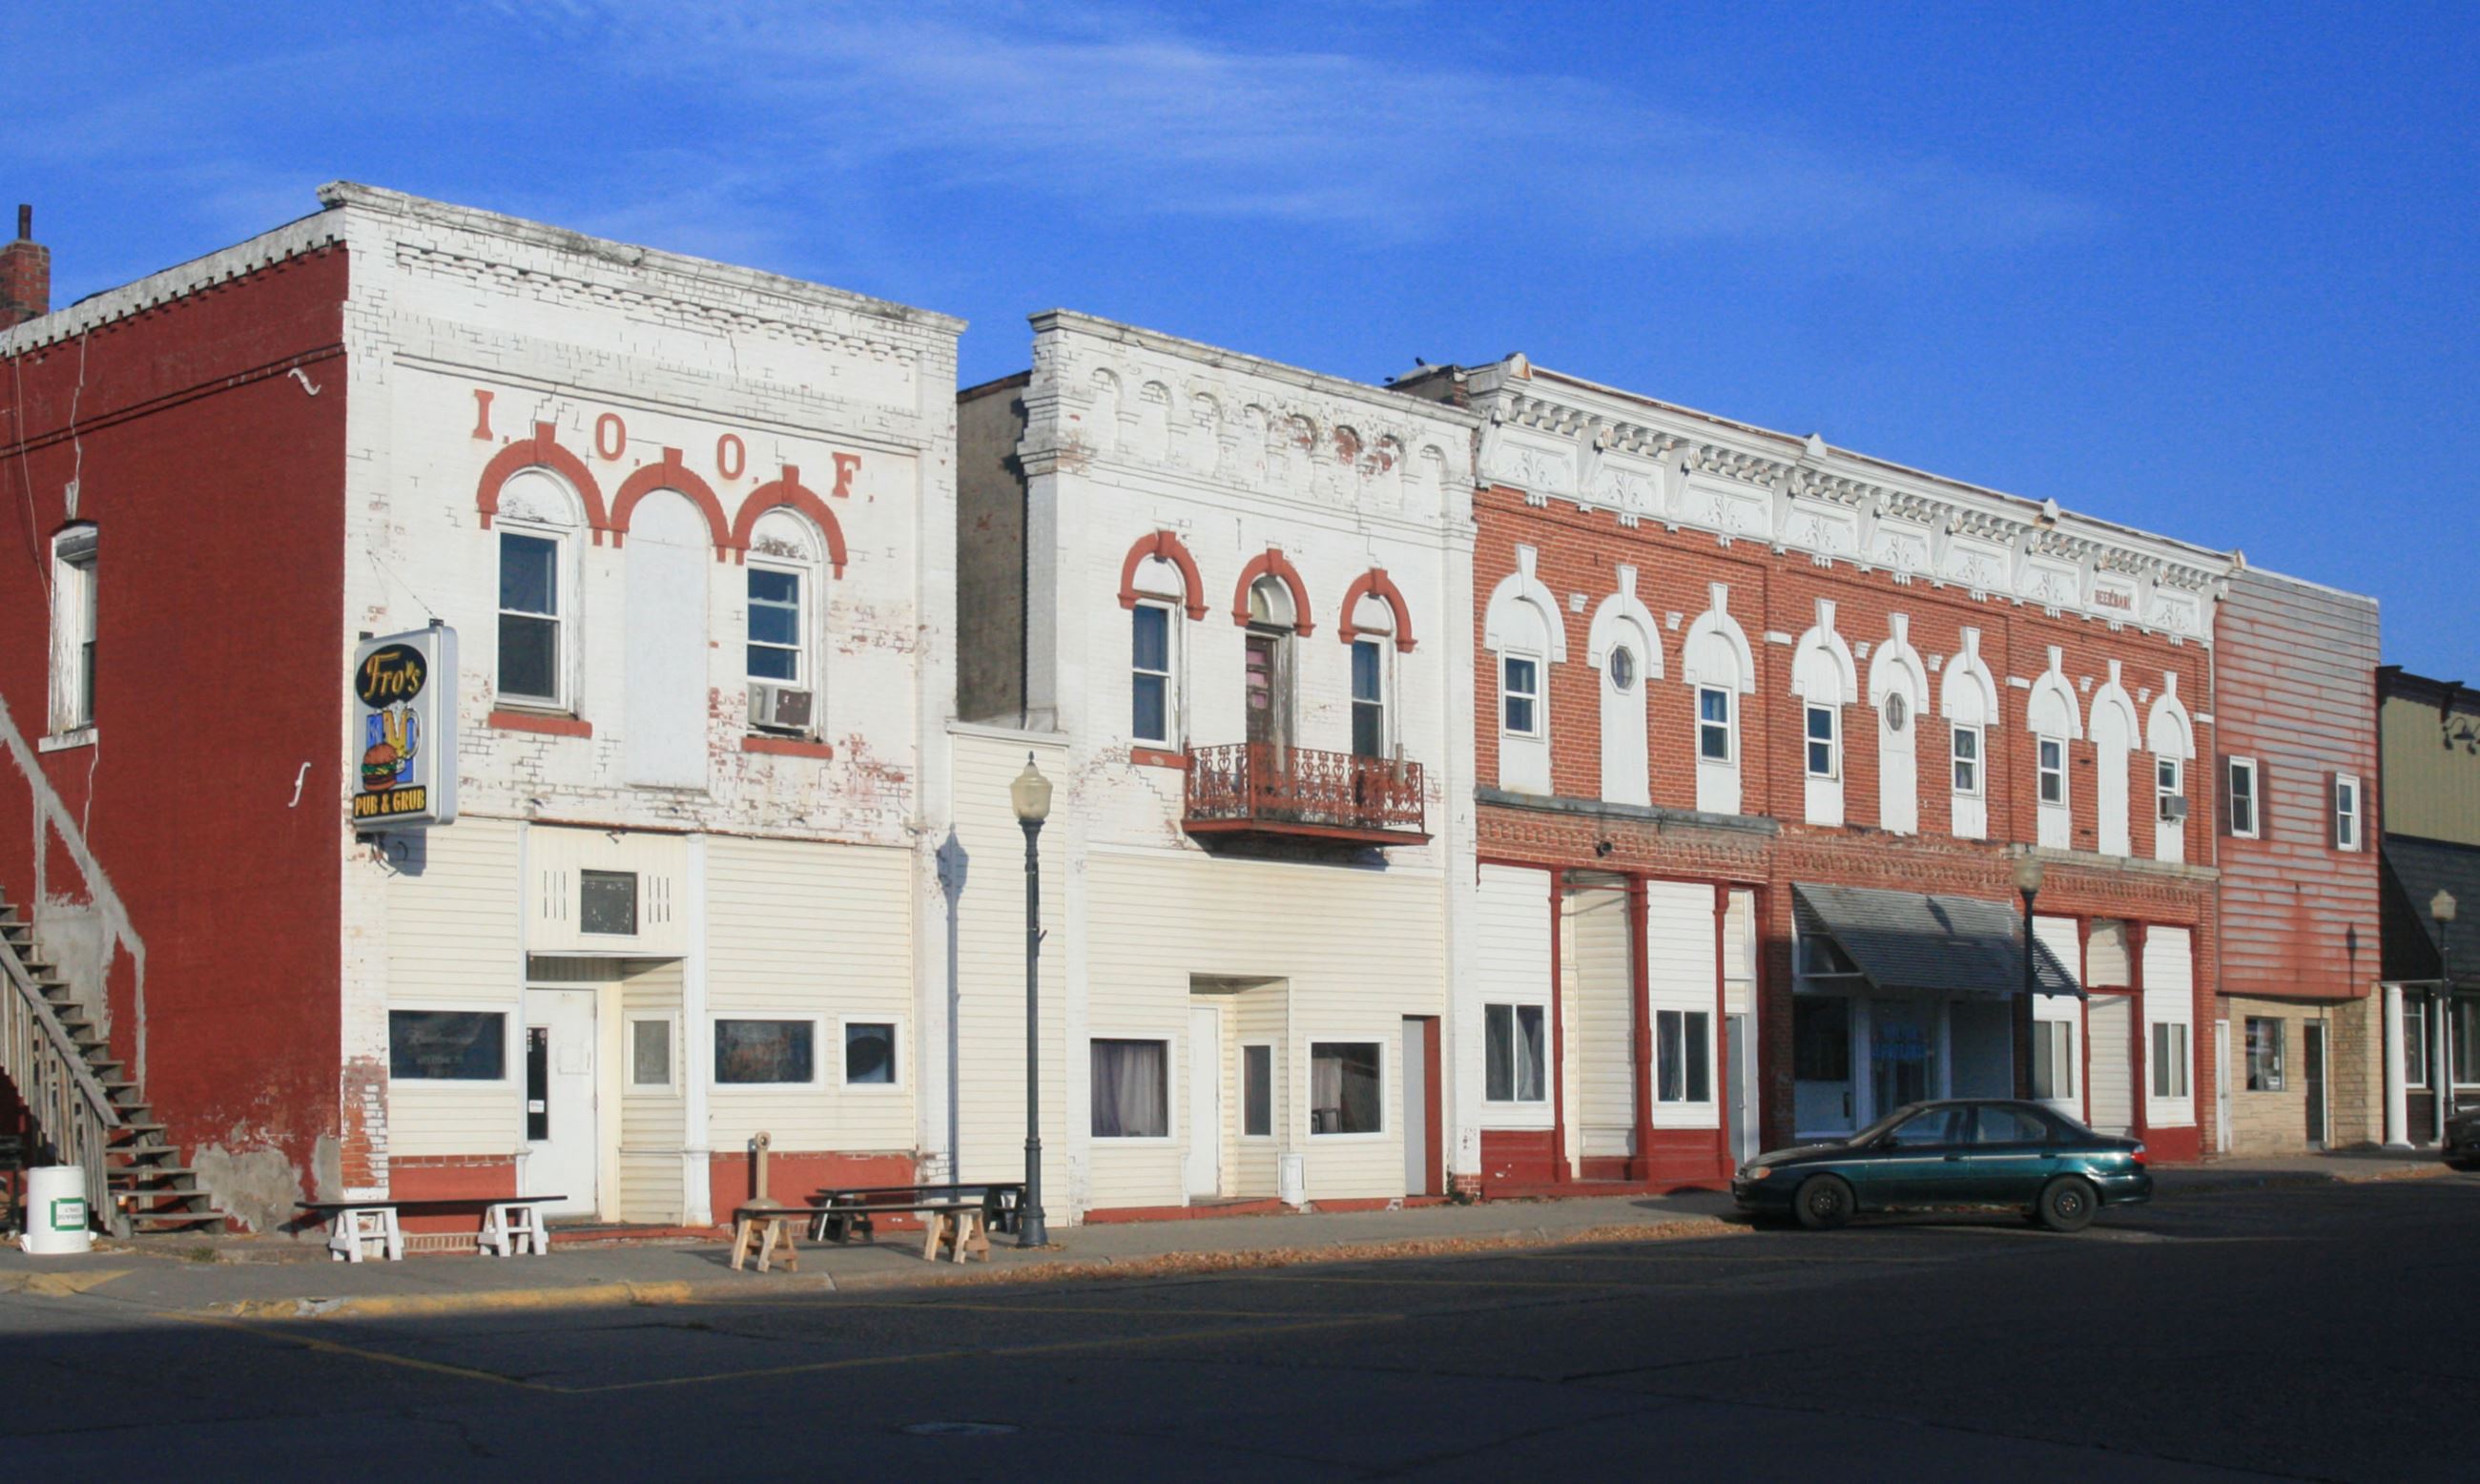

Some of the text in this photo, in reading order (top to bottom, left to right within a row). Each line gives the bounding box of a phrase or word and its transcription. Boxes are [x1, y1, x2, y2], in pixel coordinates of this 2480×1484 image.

[363, 651, 421, 700] Fro's
[355, 789, 425, 816] PUB & GRUB
